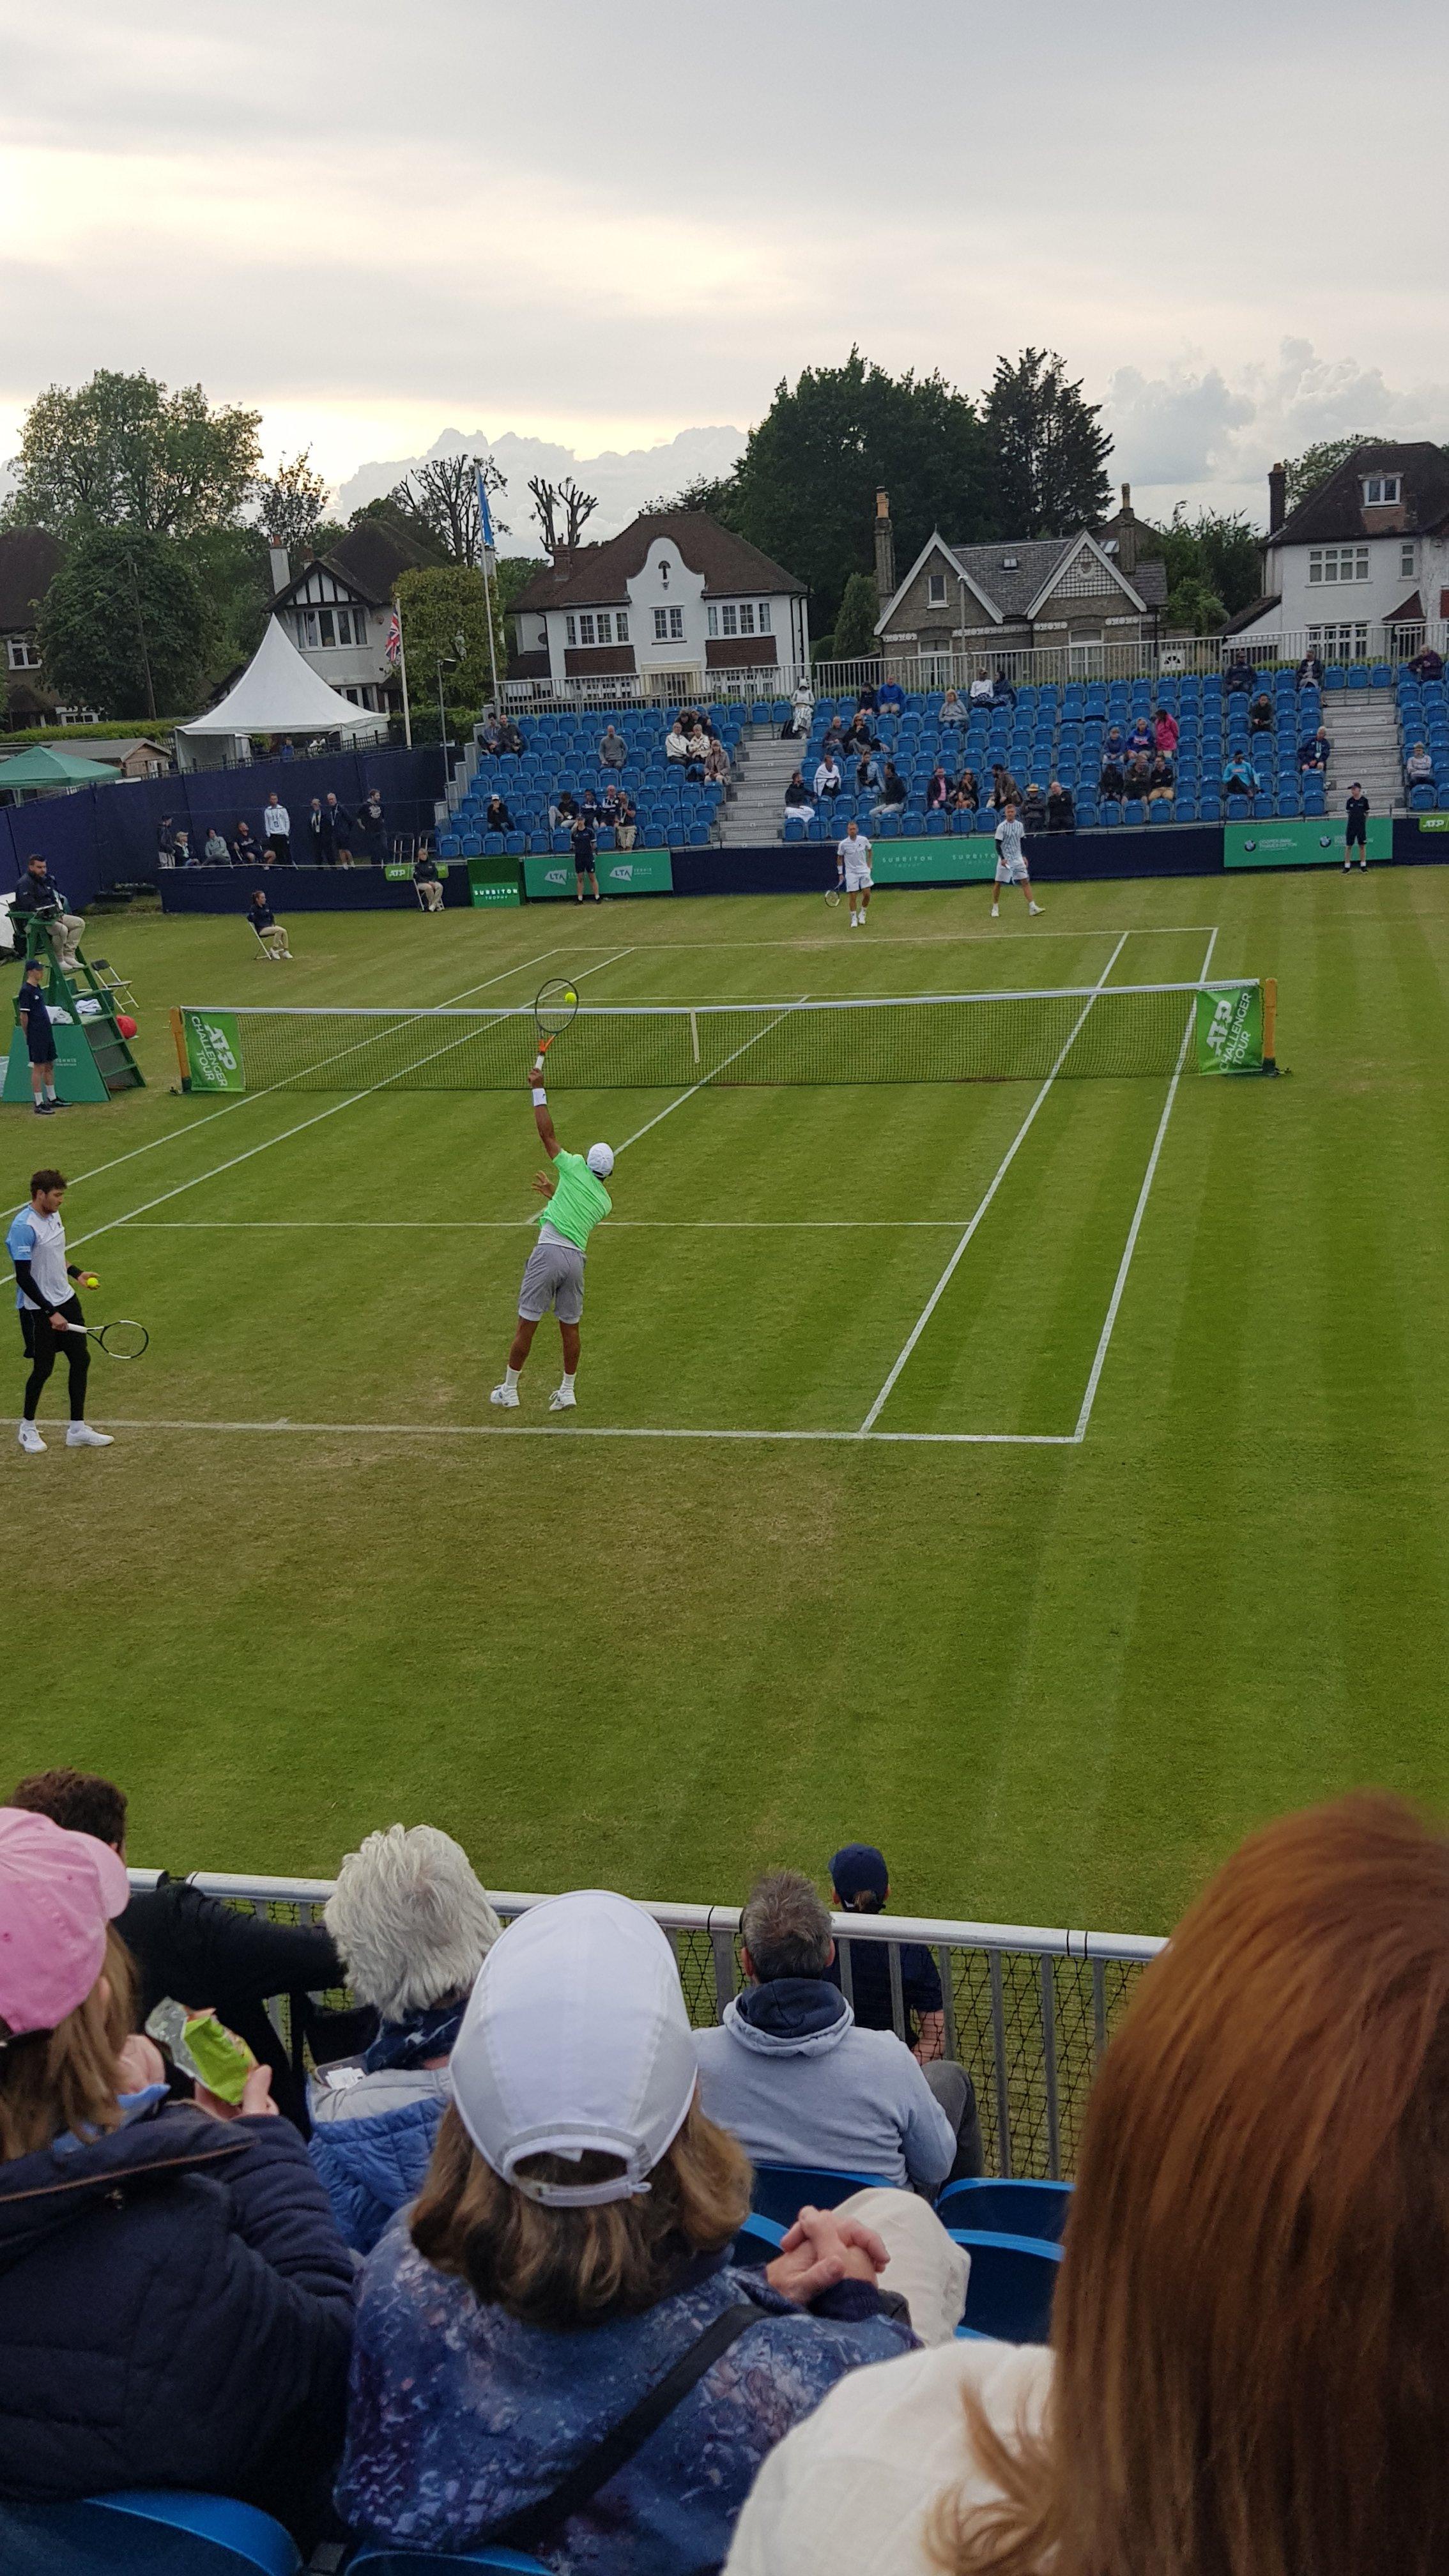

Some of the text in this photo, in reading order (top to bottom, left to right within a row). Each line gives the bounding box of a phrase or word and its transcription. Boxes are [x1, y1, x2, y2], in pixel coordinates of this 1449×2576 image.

[549, 873, 566, 881] LTA
[614, 869, 631, 877] LTA
[204, 1023, 237, 1070] ATP
[1206, 1000, 1232, 1056] ATP
[1220, 993, 1252, 1071] CHALLENGER
[1232, 1031, 1251, 1064] TOUR
[192, 1016, 228, 1086] CHALLENGER
[196, 1050, 215, 1080] TOUR
